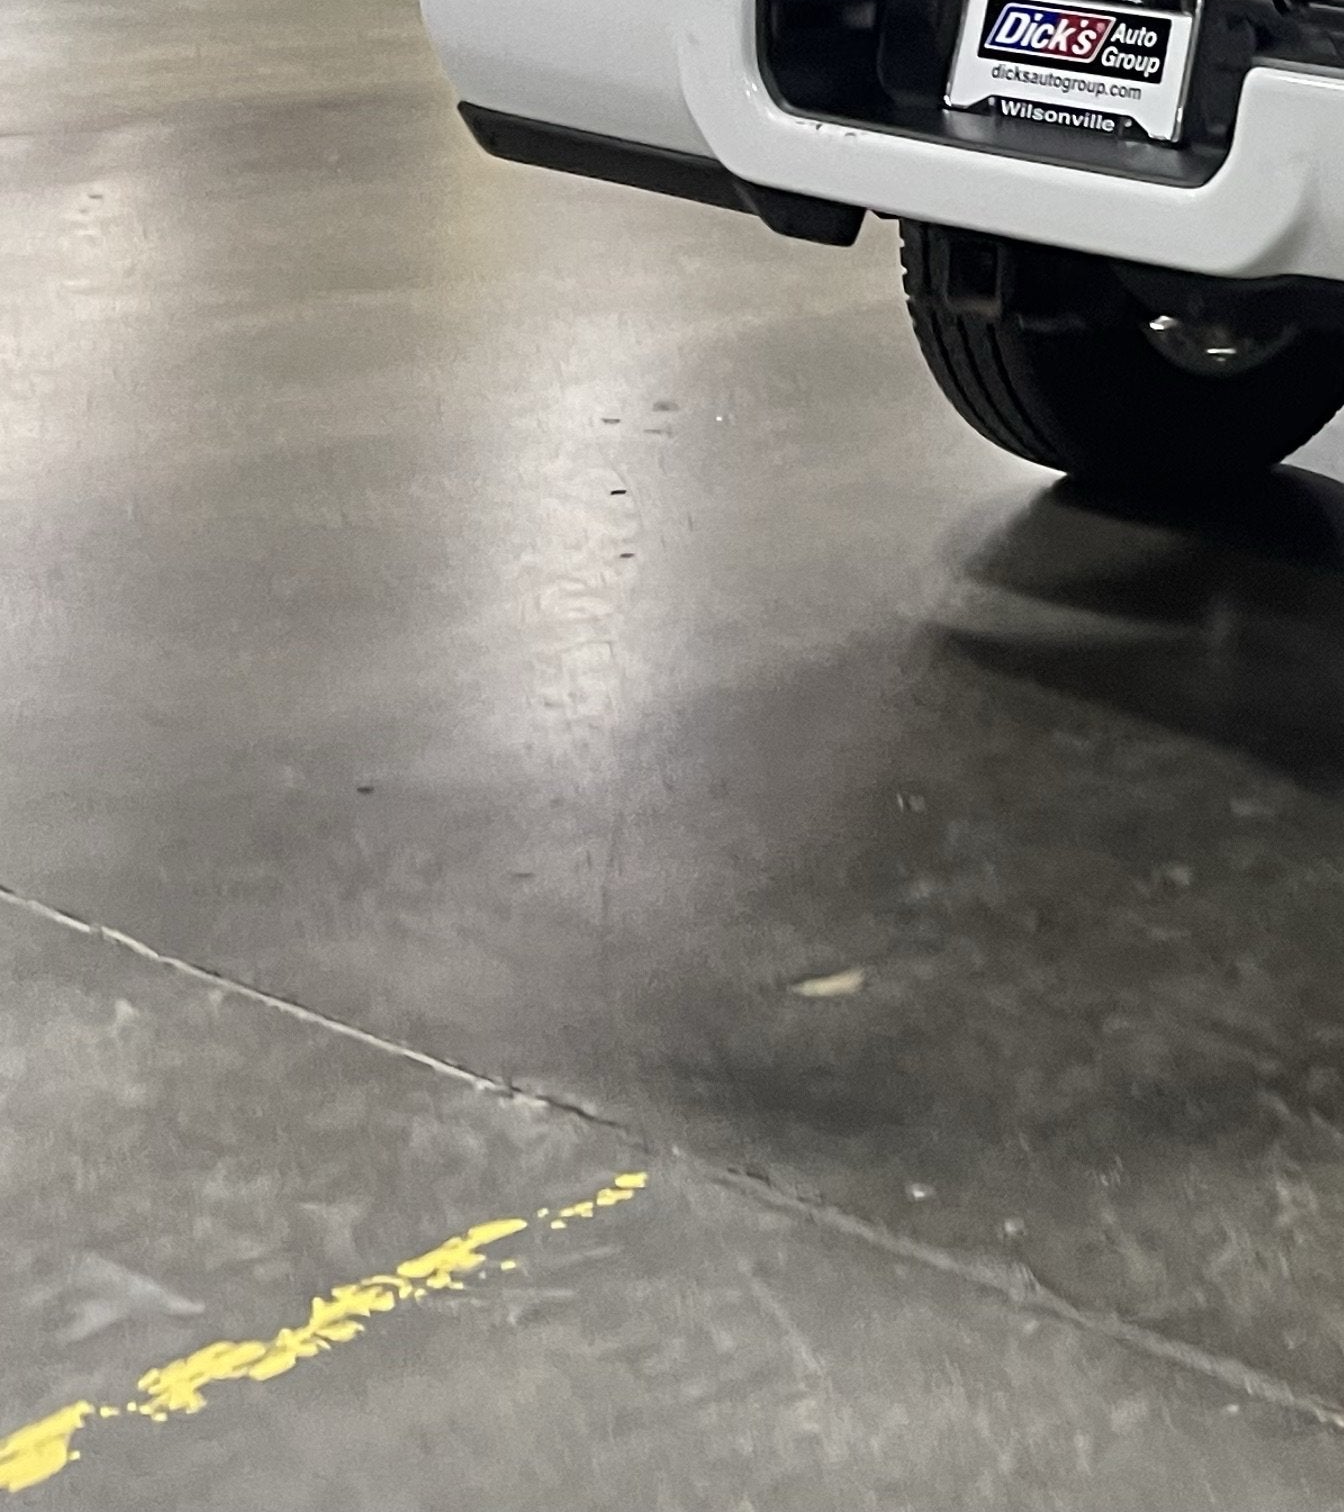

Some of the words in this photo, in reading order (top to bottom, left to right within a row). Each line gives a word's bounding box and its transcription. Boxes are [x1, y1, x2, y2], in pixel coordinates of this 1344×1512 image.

[995, 11, 1098, 56] Dick's
[1111, 22, 1158, 48] Auto
[1101, 45, 1161, 78] Group
[991, 62, 1142, 101] dicksautogroup.com
[1001, 99, 1116, 133] Wilsonville
